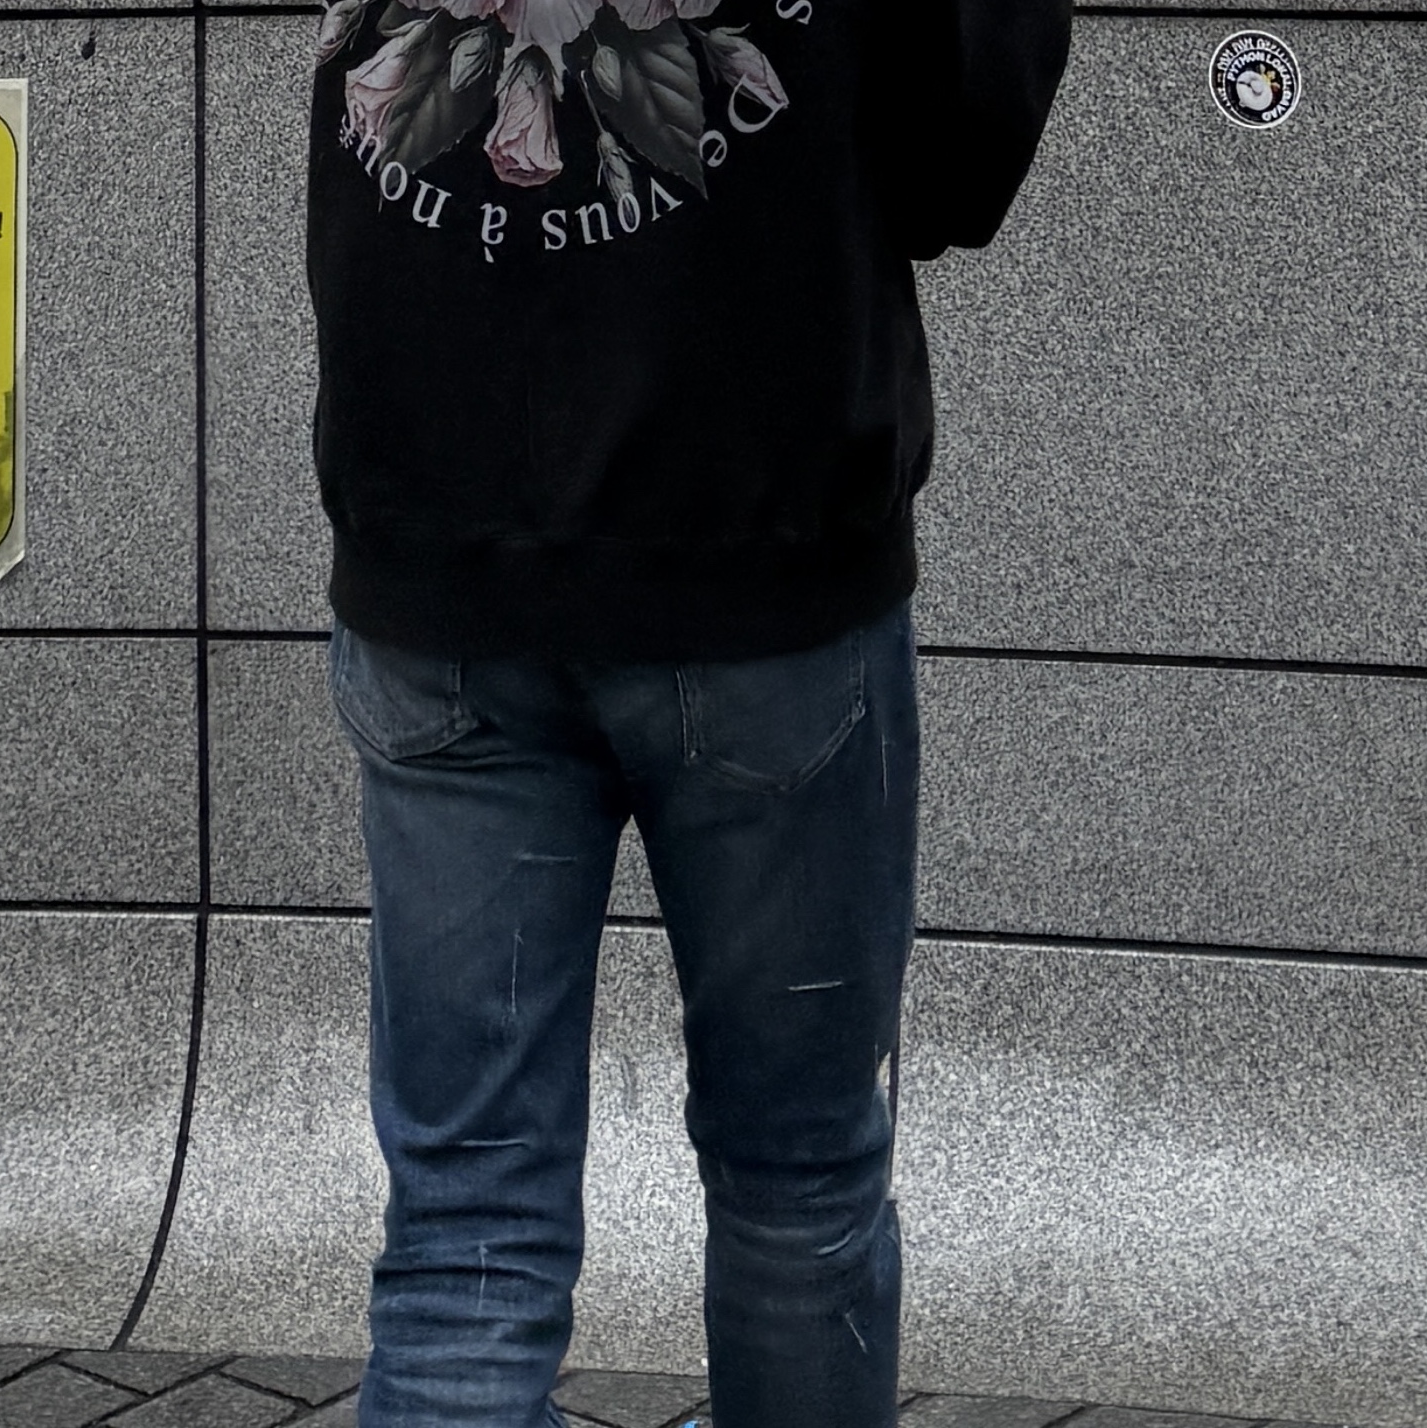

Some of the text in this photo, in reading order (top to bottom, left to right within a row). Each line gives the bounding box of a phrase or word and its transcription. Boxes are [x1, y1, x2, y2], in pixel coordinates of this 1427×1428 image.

[355, 74, 790, 264] De vous à nou
